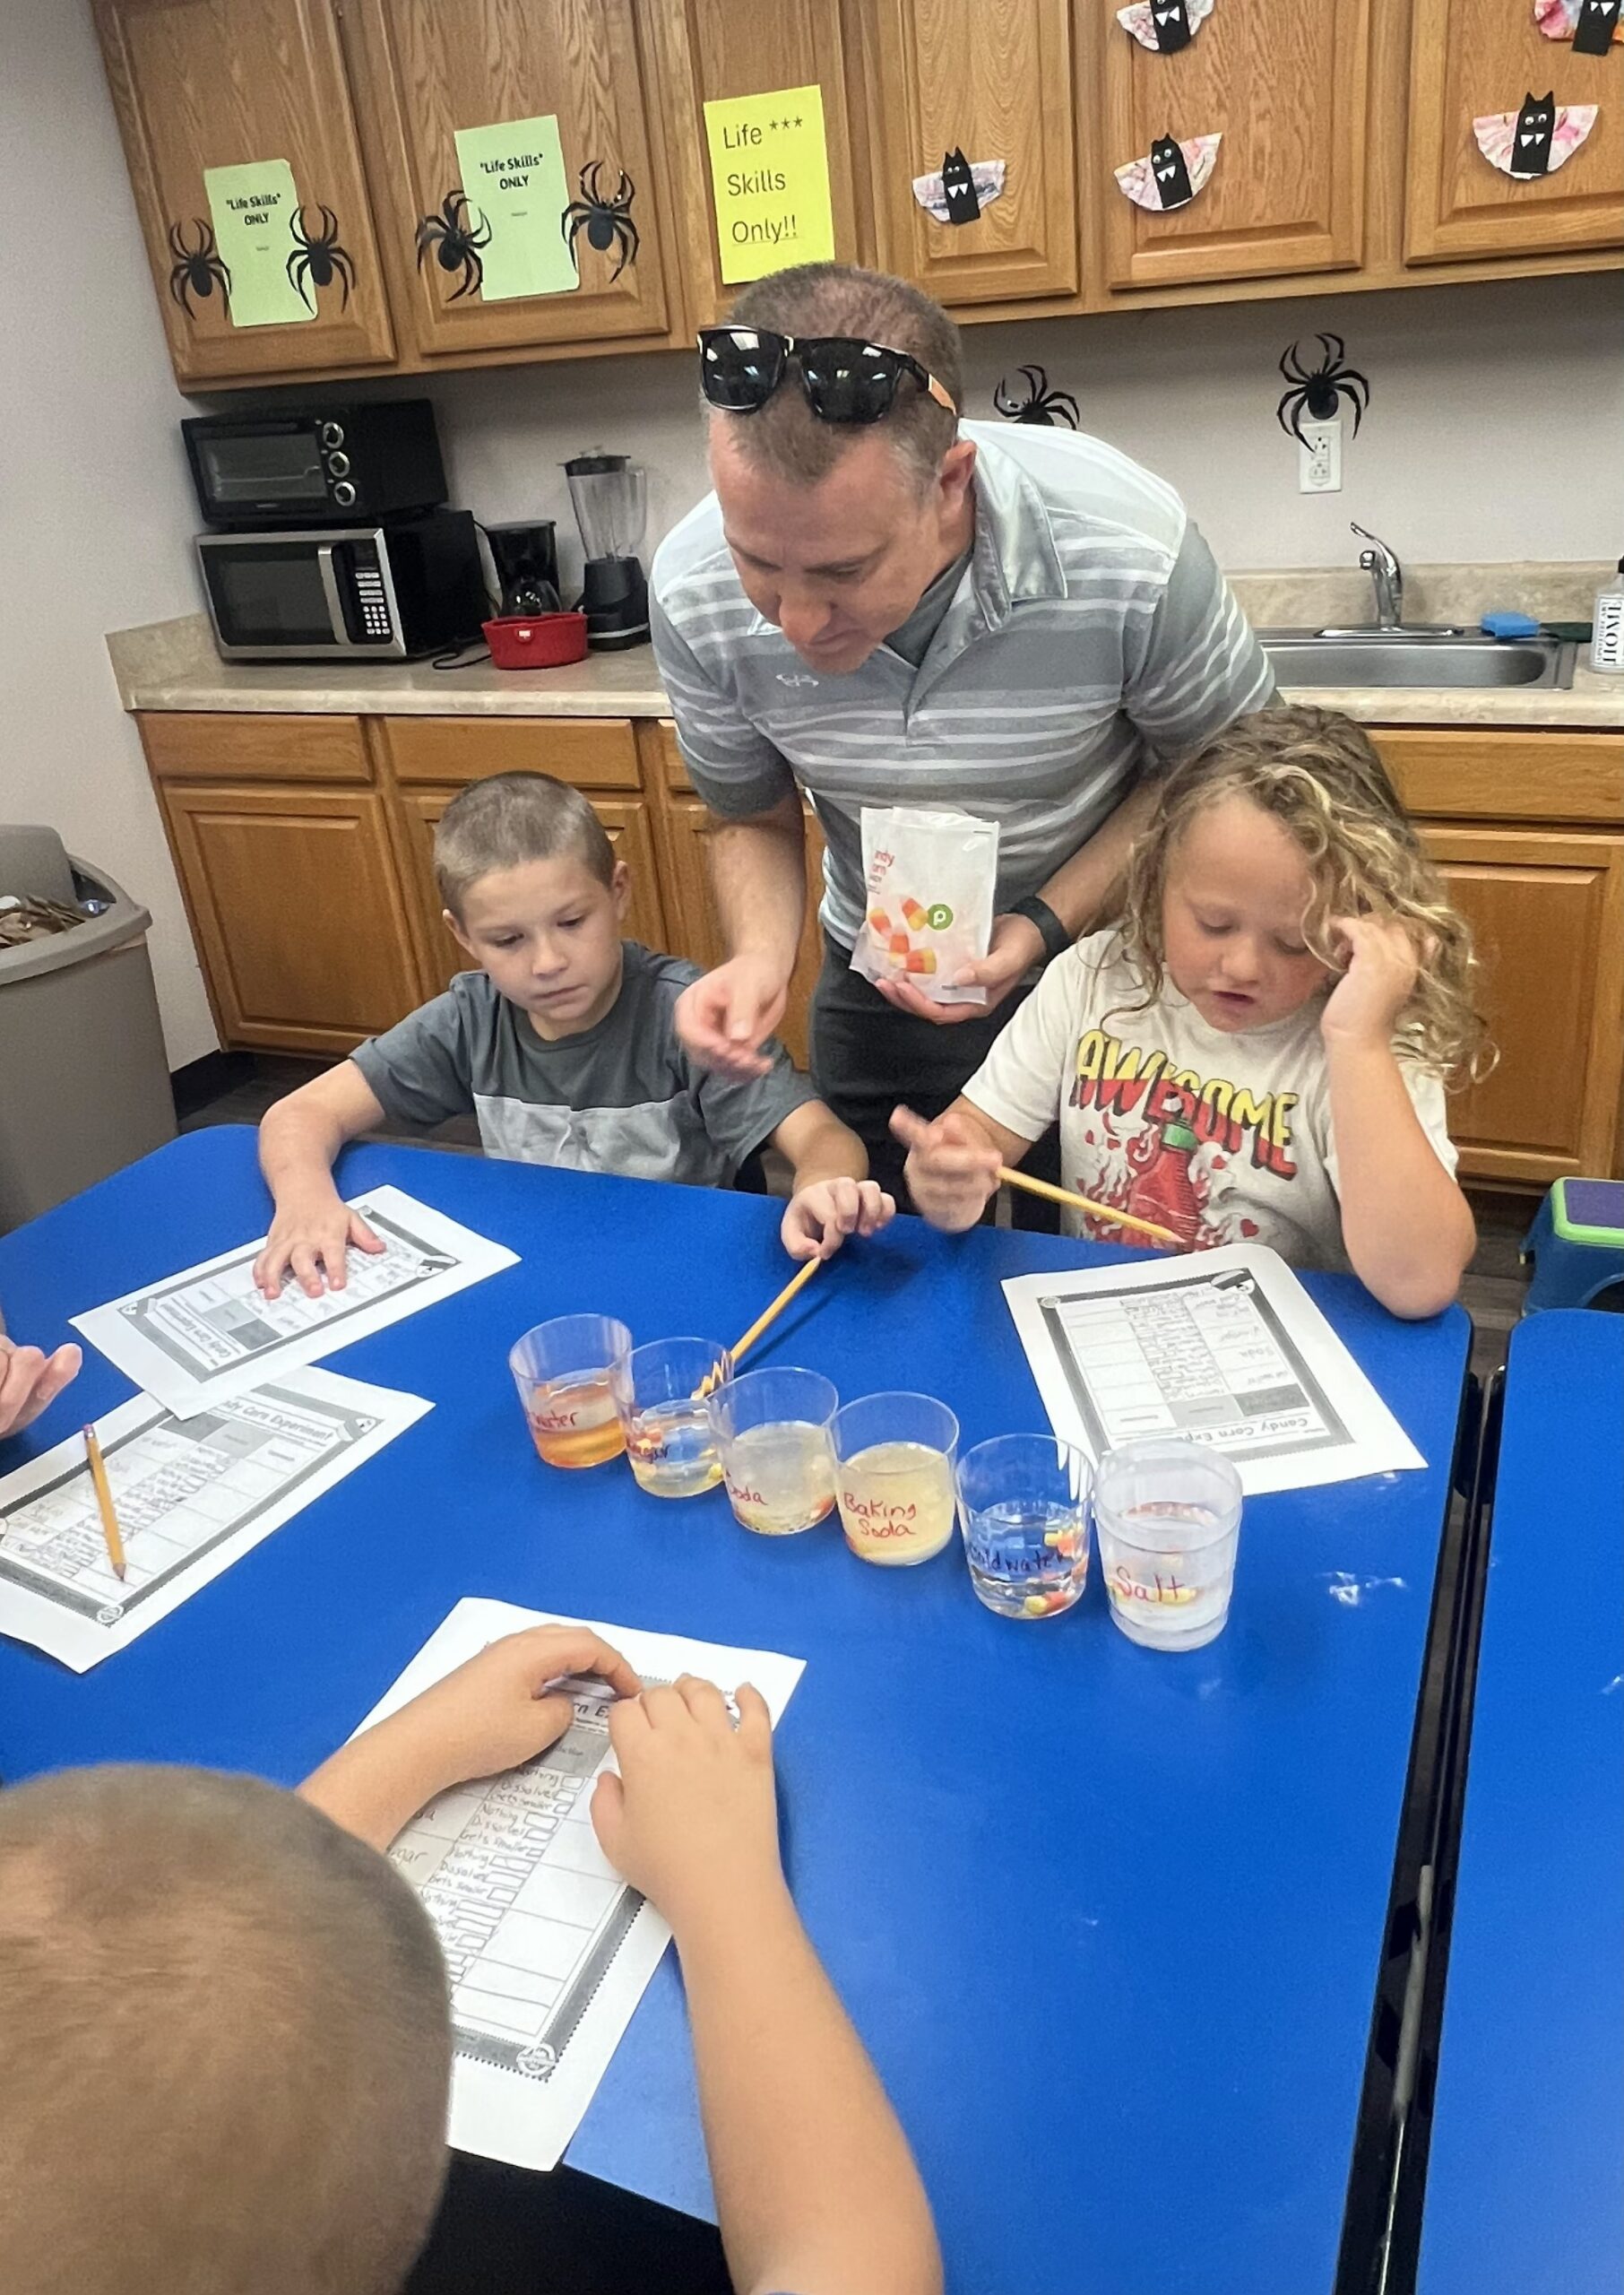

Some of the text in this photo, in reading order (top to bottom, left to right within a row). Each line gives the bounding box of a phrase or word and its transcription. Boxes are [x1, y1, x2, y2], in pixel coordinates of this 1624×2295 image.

[722, 123, 762, 149] Life
[499, 175, 530, 190] ONLY
[727, 169, 786, 196] Skills
[244, 212, 269, 226] ONLY
[731, 214, 798, 246] Only!!
[1068, 1028, 1300, 1182] AWESOME
[1218, 1426, 1254, 1438] Corn
[1261, 1417, 1309, 1432] Candy
[858, 1518, 918, 1538] Soda
[1116, 1565, 1186, 1603] Salt
